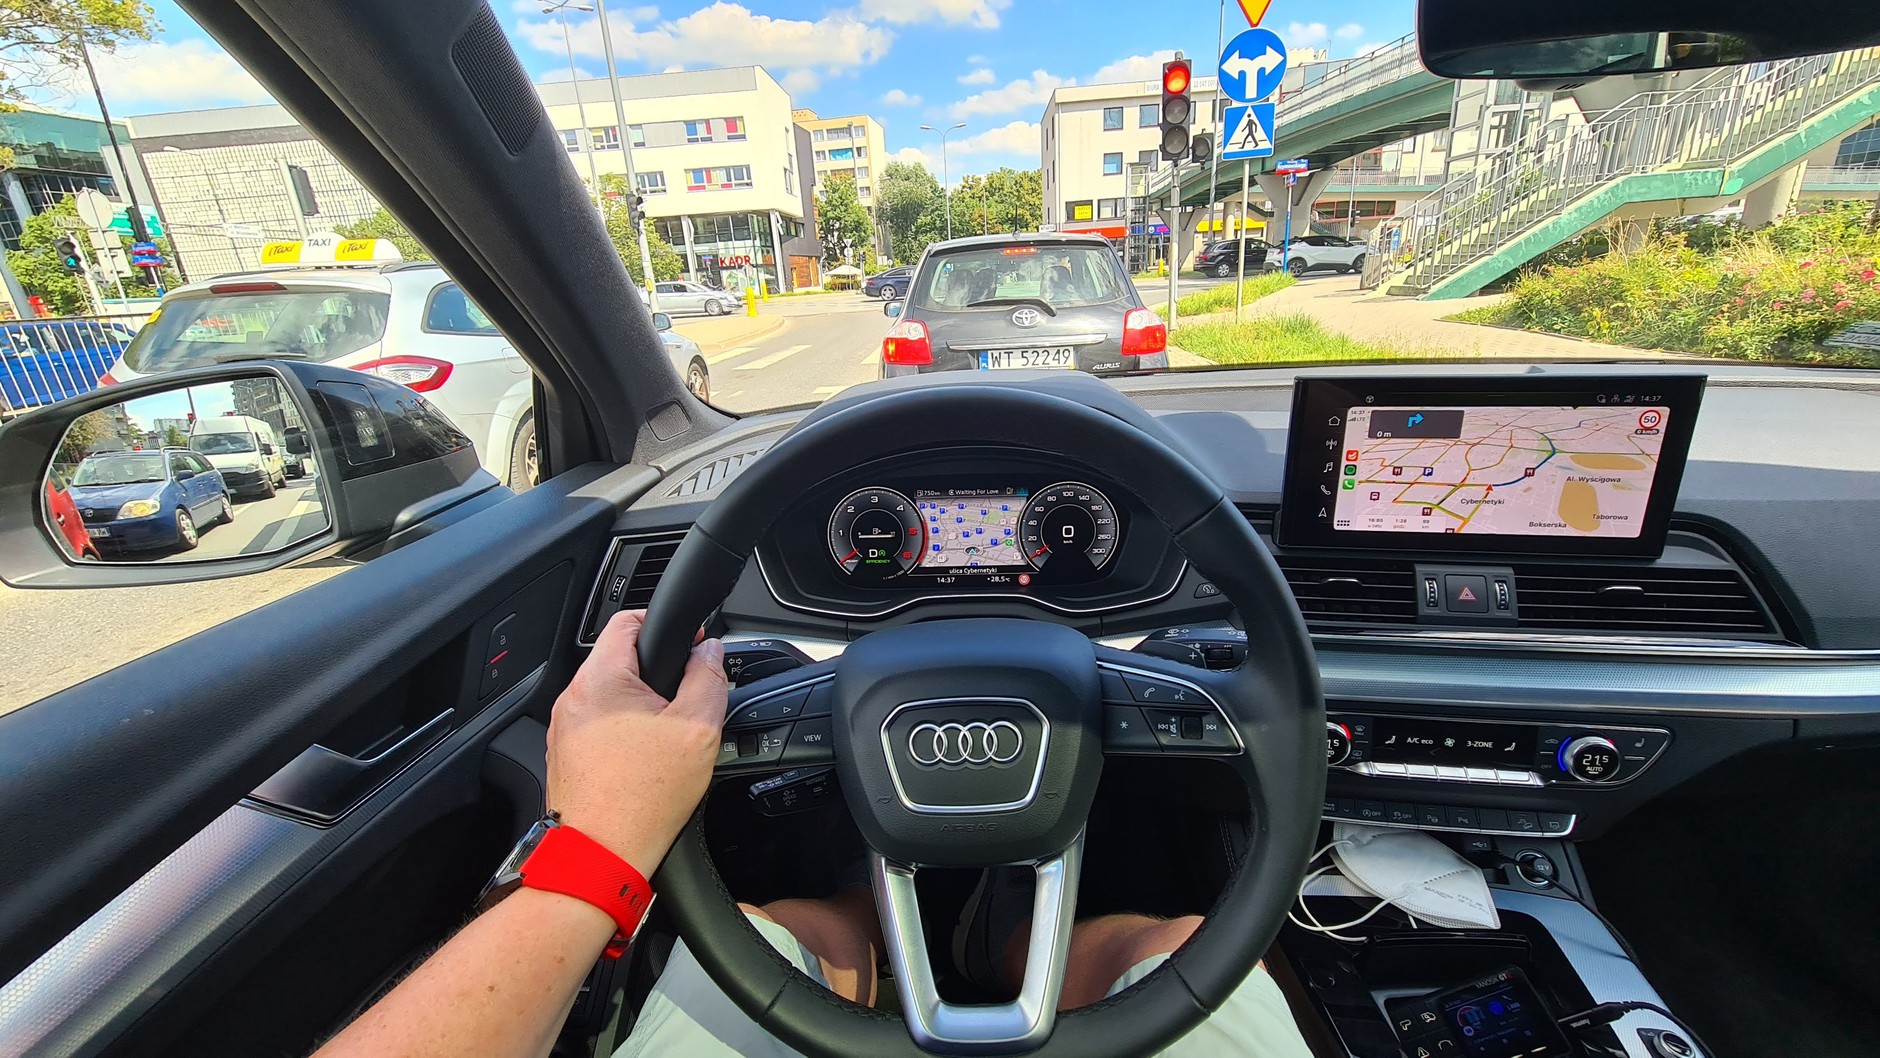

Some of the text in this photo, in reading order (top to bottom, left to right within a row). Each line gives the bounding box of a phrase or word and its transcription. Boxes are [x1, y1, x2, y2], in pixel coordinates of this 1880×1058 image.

[308, 238, 331, 247] TAXI
[268, 244, 295, 257] iTaxi
[342, 241, 368, 254] iTaxi
[719, 255, 751, 267] KADR
[991, 348, 1071, 368] WT 52249
[1092, 362, 1121, 370] AURIS
[1643, 415, 1657, 424] 50
[847, 505, 855, 513] 2
[1062, 525, 1074, 538] 0
[868, 549, 878, 558] D
[963, 567, 998, 575] Cybernetyki
[803, 734, 822, 742] VIEW
[1466, 740, 1494, 749] 3-ZONE
[941, 822, 998, 832] AIRBAG
